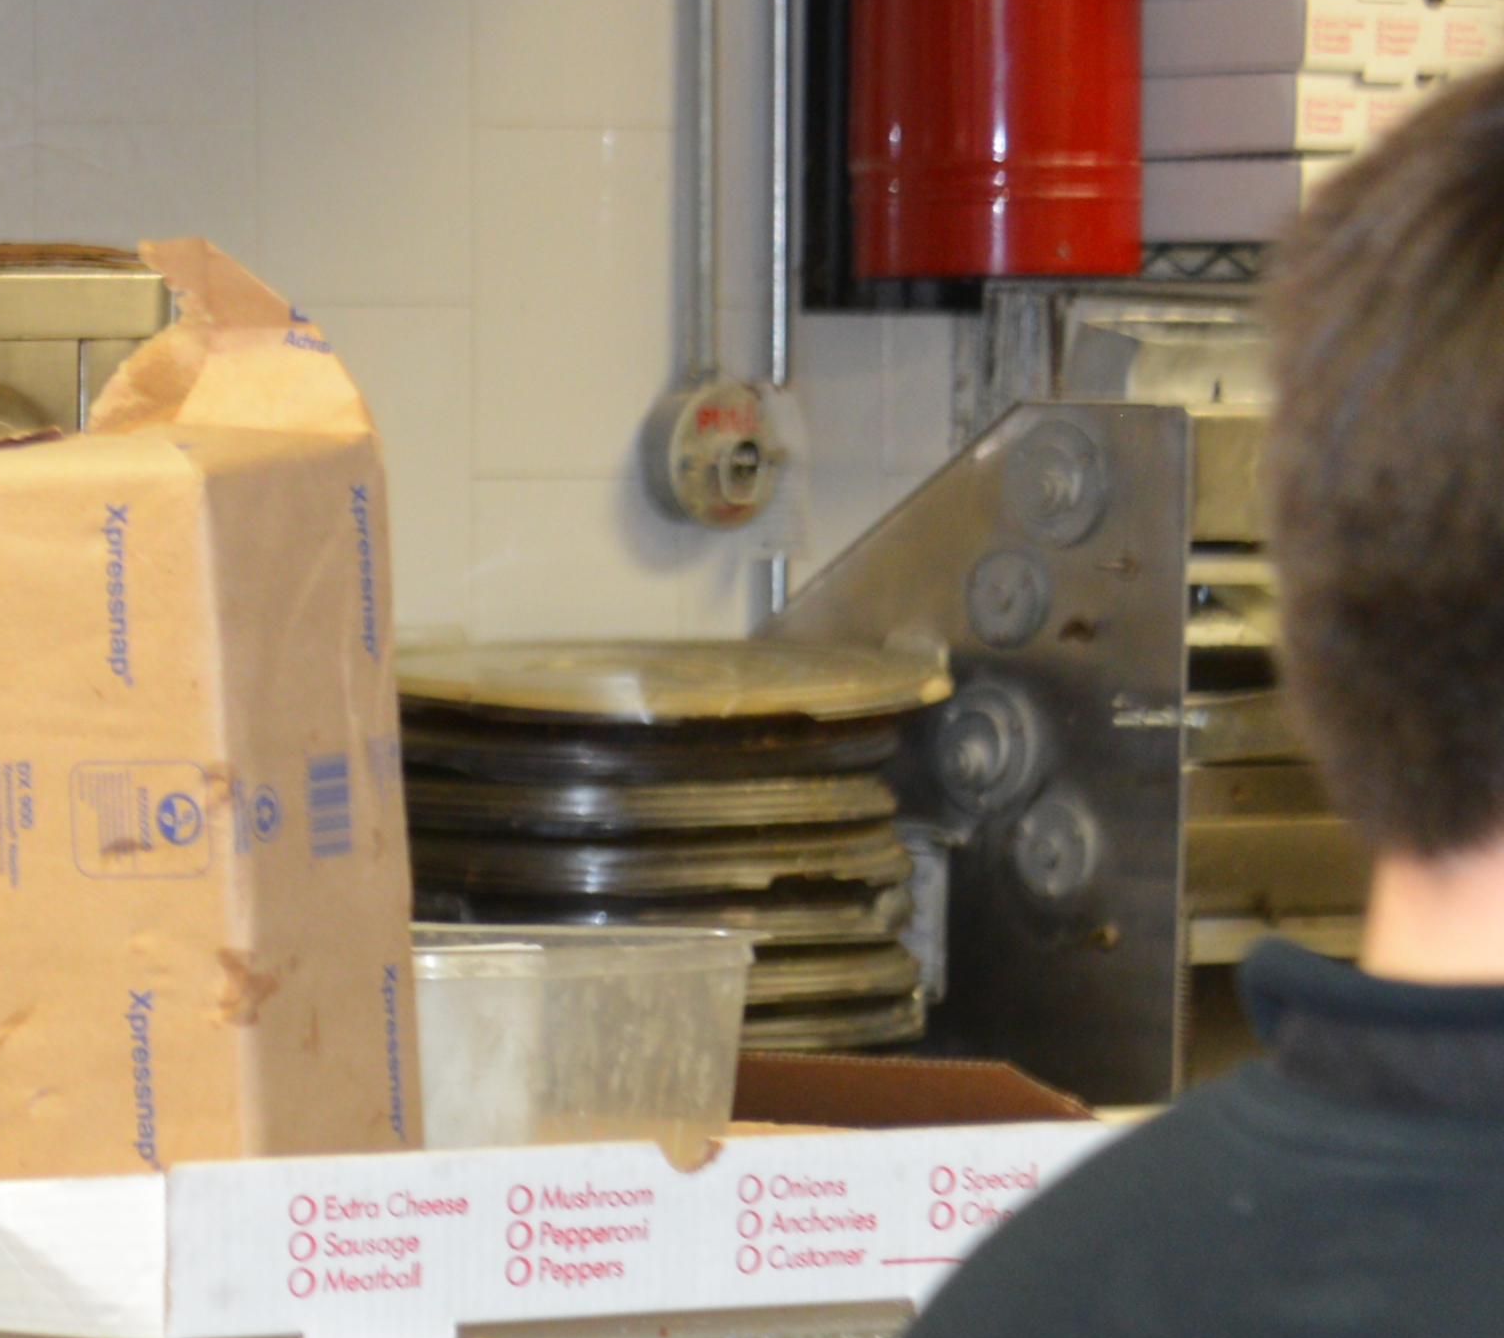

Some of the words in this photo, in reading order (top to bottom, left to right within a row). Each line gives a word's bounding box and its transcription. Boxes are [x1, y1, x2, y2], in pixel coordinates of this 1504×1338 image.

[101, 503, 131, 683] Xpressnap
[124, 989, 157, 1165] Xpressnap
[540, 1180, 656, 1210] Mushroom
[769, 1174, 848, 1200] Onions
[961, 1162, 1039, 1199] Special
[324, 1194, 381, 1222] Extra
[388, 1190, 470, 1219] Cheese
[768, 1206, 878, 1236] Anchovies
[961, 1199, 1015, 1226] Othe
[323, 1232, 421, 1261] Sausage
[539, 1217, 650, 1253] Pepperoni
[539, 1256, 626, 1289] Peppers
[767, 1244, 868, 1270] Customer
[323, 1261, 423, 1293] Meatball
